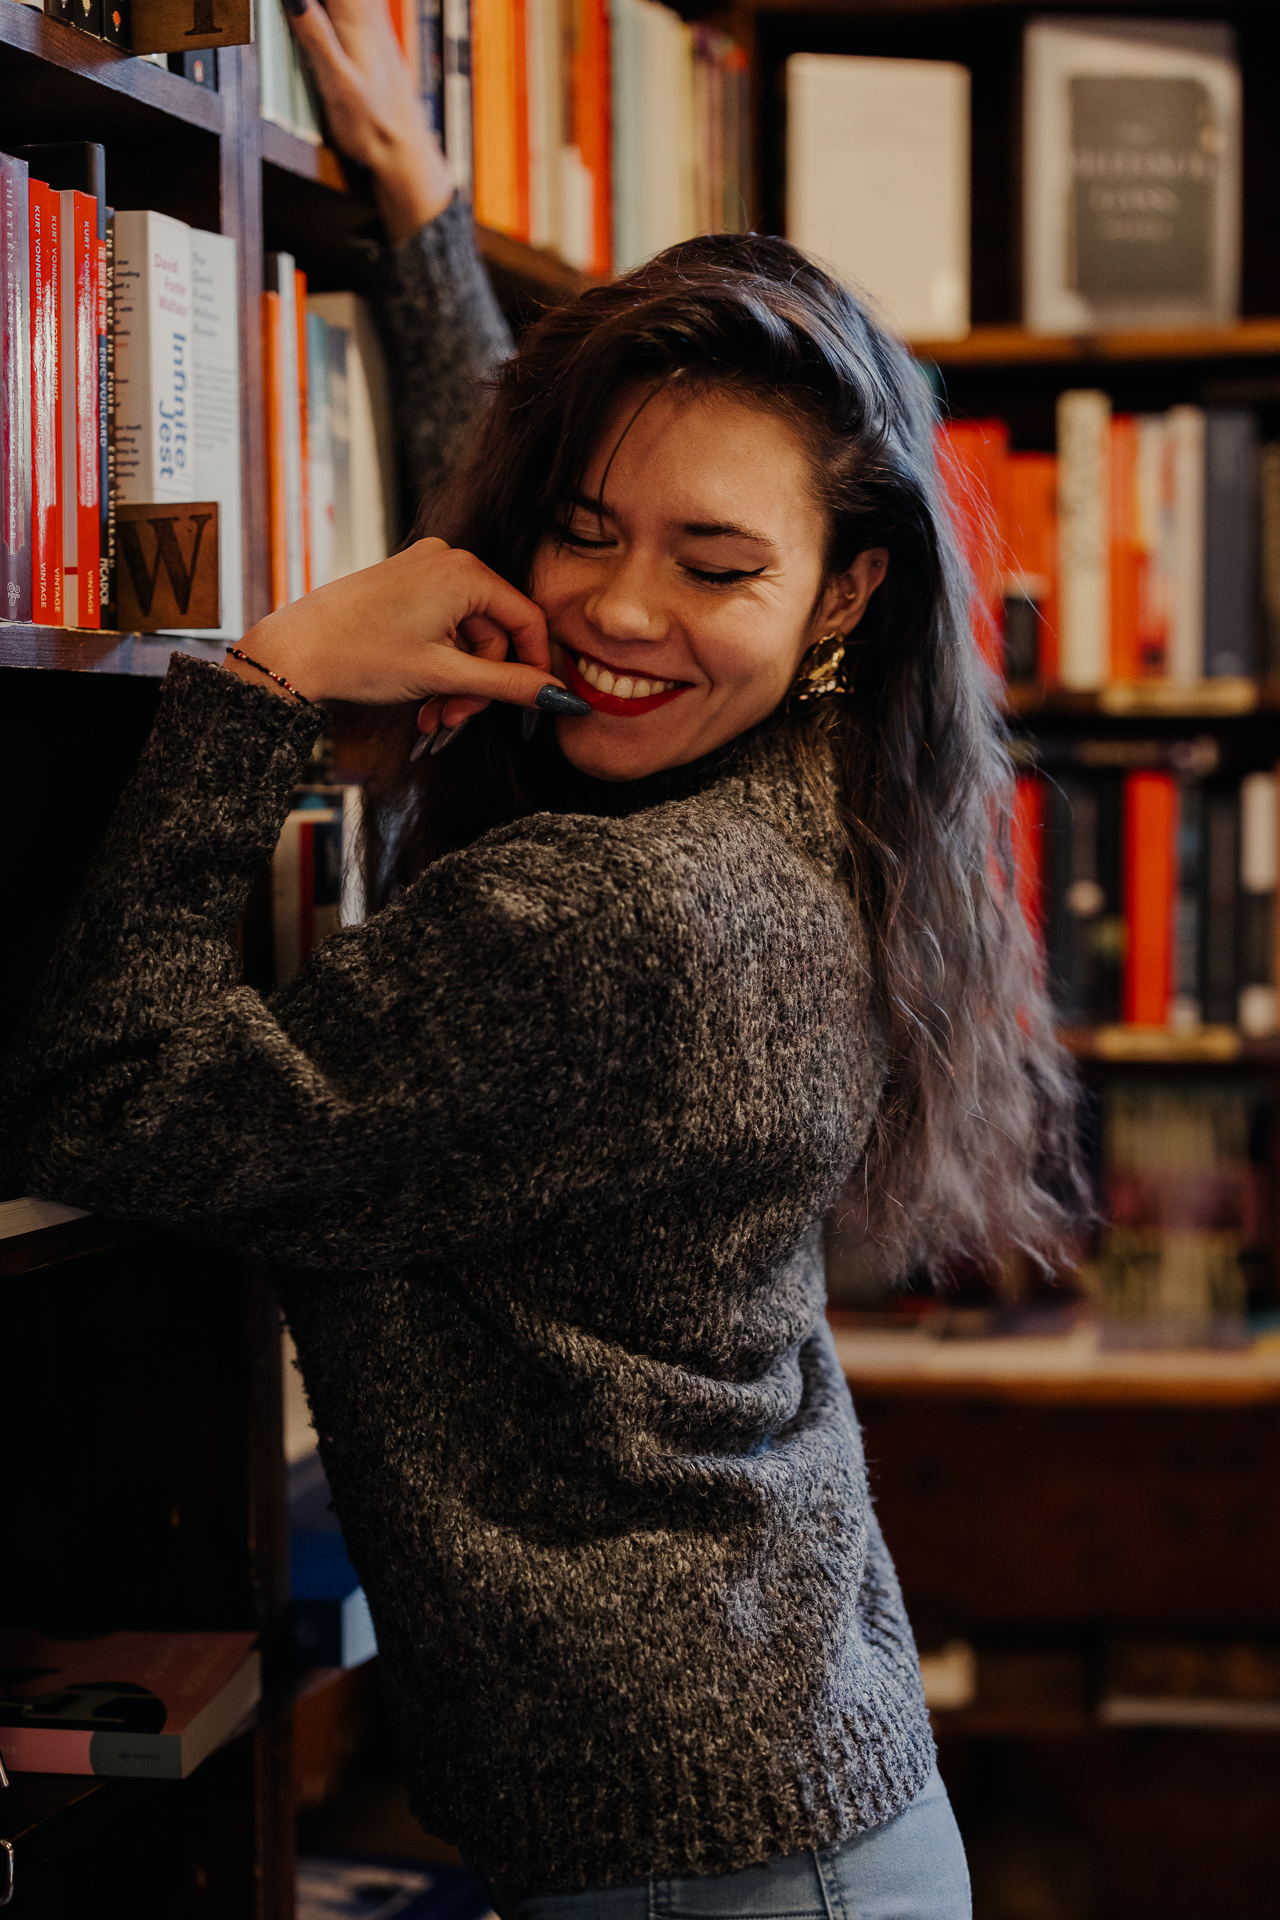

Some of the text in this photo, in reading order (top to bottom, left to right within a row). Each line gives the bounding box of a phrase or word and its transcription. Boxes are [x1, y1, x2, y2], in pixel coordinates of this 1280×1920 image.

[34, 205, 42, 235] KURT
[6, 177, 15, 335] THIRTEEN SENSES
[97, 246, 106, 261] THE
[106, 228, 114, 259] THE
[35, 238, 43, 302] VONNEGUT
[51, 247, 59, 310] VONNEGUT
[97, 261, 106, 288] ORDER
[106, 266, 114, 299] WAR
[106, 306, 114, 326] OF
[107, 334, 115, 364] THE
[99, 347, 108, 448] ERIC VUILLARD
[173, 332, 188, 469] Infinite
[159, 399, 175, 479] Jest
[107, 445, 116, 482] ERIC
[99, 557, 110, 606] PICADOR
[113, 513, 213, 618] W
